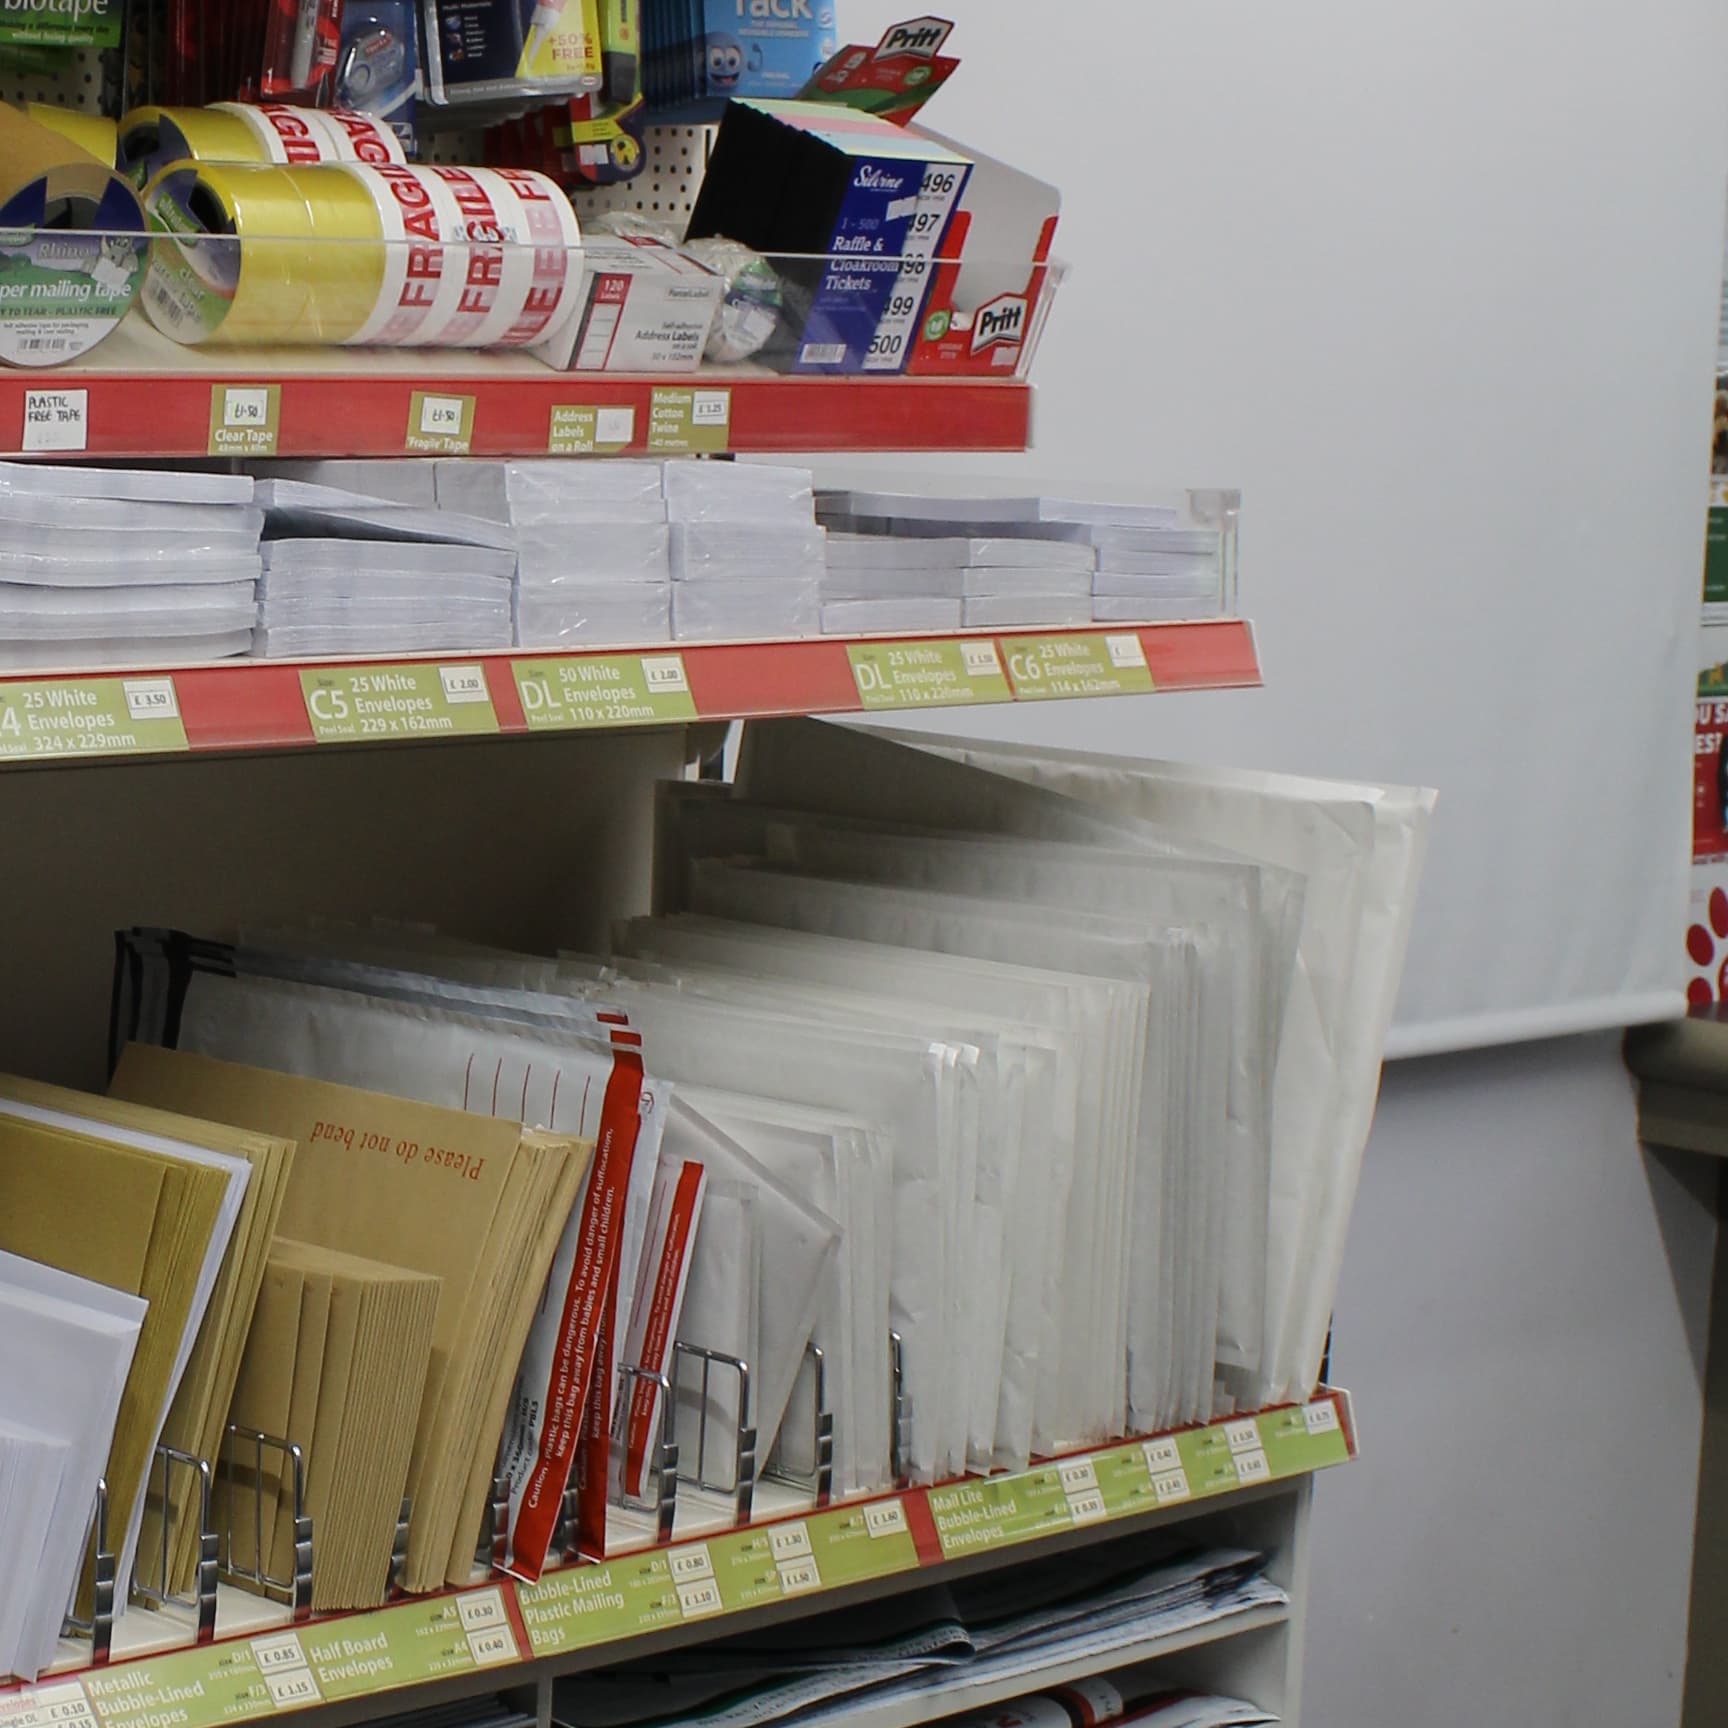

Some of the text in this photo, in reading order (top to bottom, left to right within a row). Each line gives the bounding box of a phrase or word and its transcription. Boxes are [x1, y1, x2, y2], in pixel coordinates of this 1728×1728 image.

[885, 25, 944, 51] Pritt
[832, 236, 871, 254] Raffle
[29, 279, 91, 303] mailing
[825, 275, 872, 292] Tickets
[979, 307, 1022, 338] Pritt
[28, 396, 69, 409] PLASTIC
[553, 409, 593, 424] Address
[652, 407, 685, 421] Cotton
[214, 427, 274, 445] Clear Tape
[553, 425, 584, 439] Labels
[371, 675, 417, 693] White
[579, 665, 621, 682] White
[46, 689, 98, 708] White
[310, 689, 350, 721] C5
[519, 679, 561, 710] DL
[563, 686, 637, 704] Envelopes
[354, 696, 433, 716] Envelopes
[28, 711, 116, 733] Envelopes
[79, 732, 137, 751] 229mm
[310, 1120, 487, 1181] Please do not bend
[525, 1590, 625, 1626] Plastic Mailing
[531, 1626, 566, 1648] Bags
[310, 1632, 388, 1665] Half Board
[317, 1656, 394, 1685] Envelopes
[87, 1671, 154, 1697] Metallic
[97, 1680, 205, 1717] Bubble-Lined
